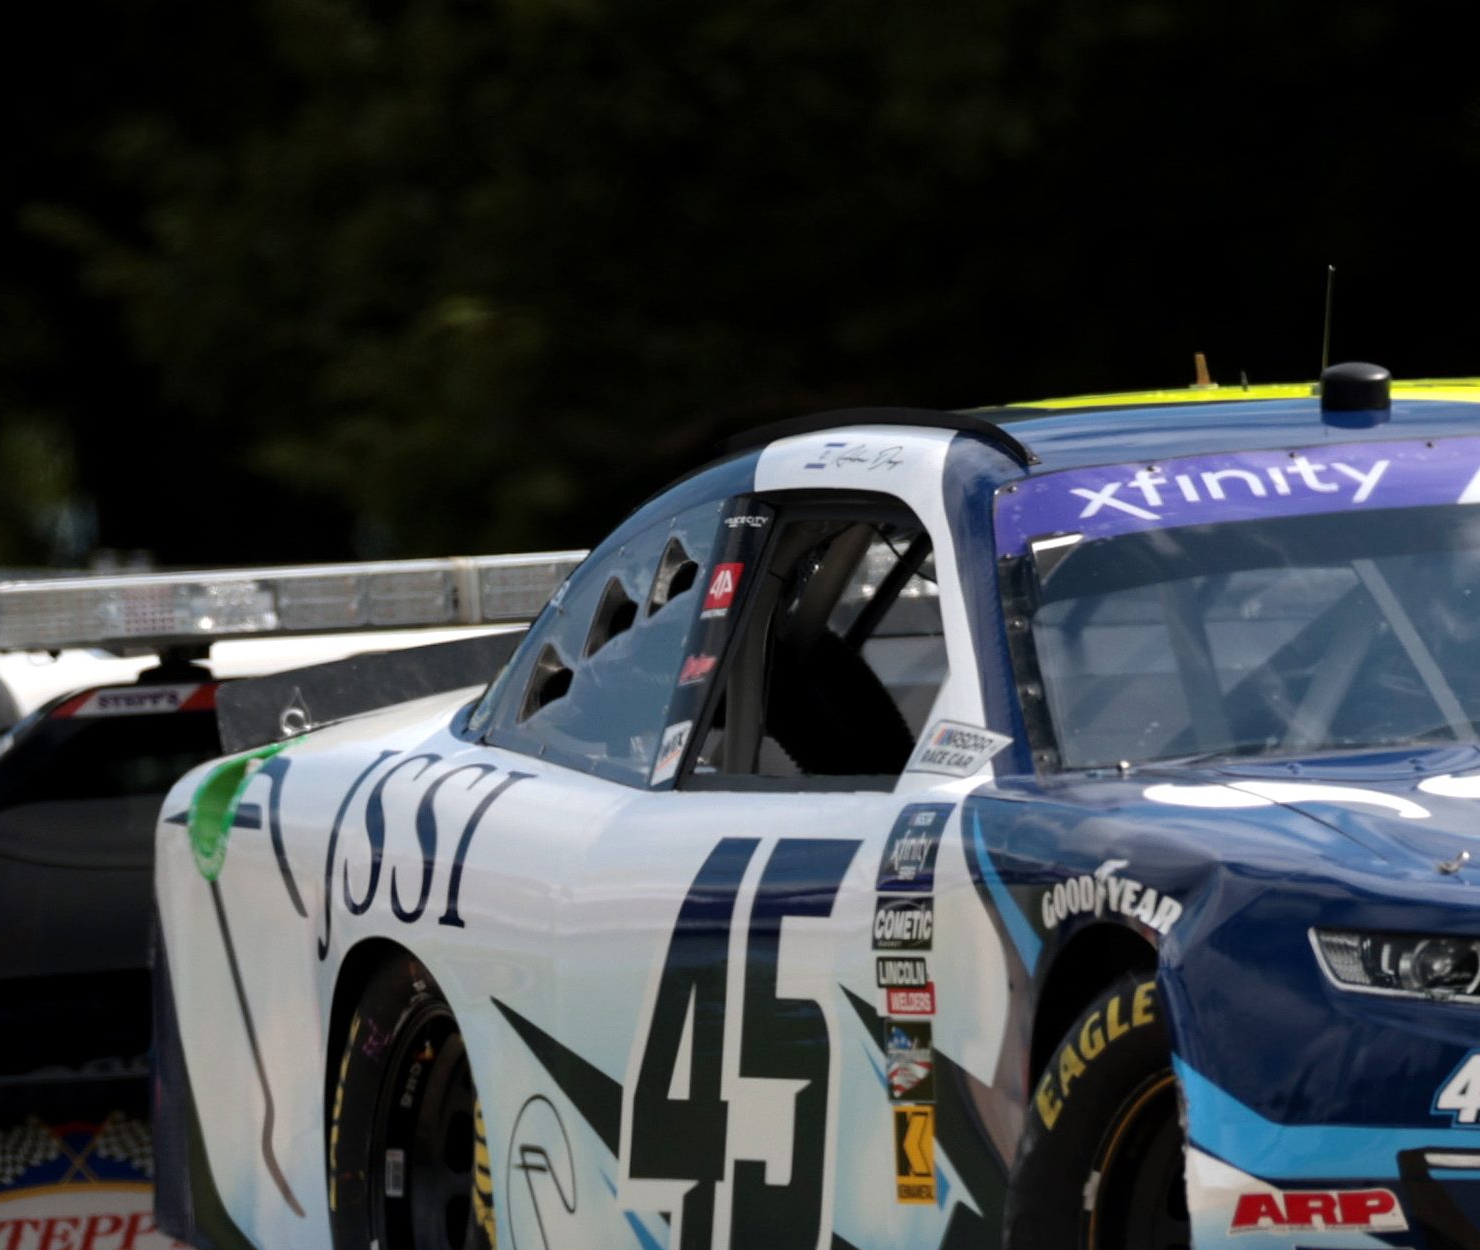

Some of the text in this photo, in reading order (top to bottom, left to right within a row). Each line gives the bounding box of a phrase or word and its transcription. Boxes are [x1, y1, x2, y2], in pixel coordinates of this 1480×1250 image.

[1068, 456, 1391, 520] xfinity
[946, 752, 974, 768] CAR
[1041, 869, 1183, 936] GOODYEAR
[874, 909, 932, 940] COMETIC
[879, 960, 925, 985] LINCOLN
[1035, 980, 1157, 1131] EAGLE
[1230, 1190, 1396, 1227] ARP
